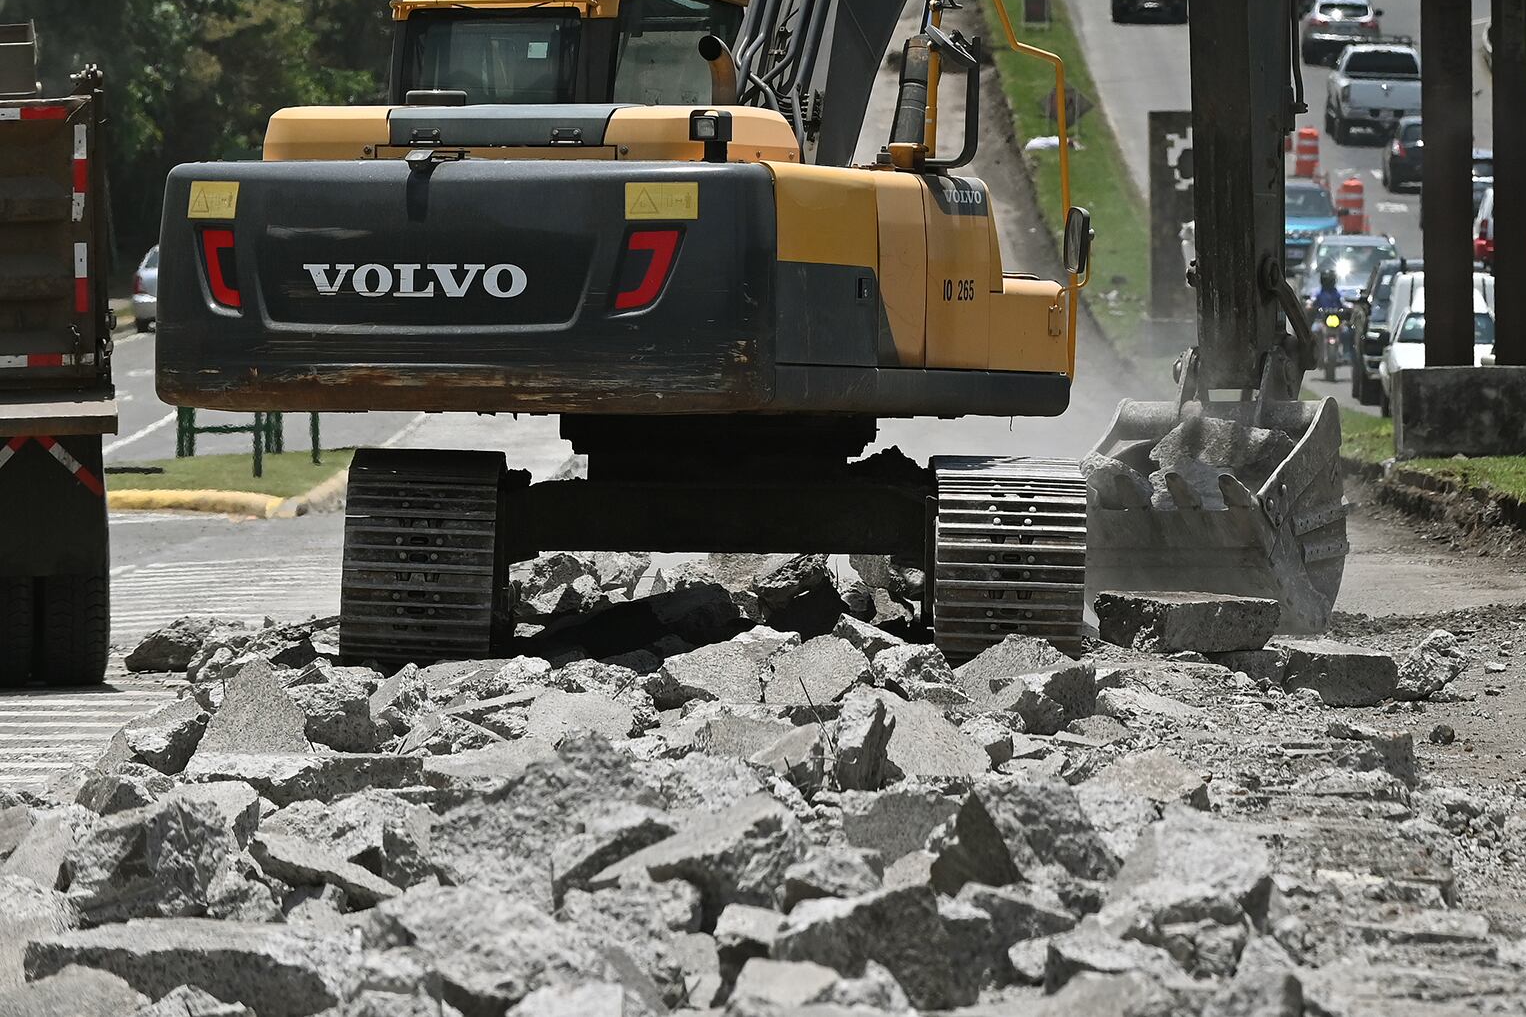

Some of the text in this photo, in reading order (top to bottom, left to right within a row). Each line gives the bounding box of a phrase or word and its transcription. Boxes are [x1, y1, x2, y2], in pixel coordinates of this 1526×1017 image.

[943, 189, 982, 204] VOLVO
[303, 263, 528, 298] VOLVO
[957, 280, 974, 301] 265
